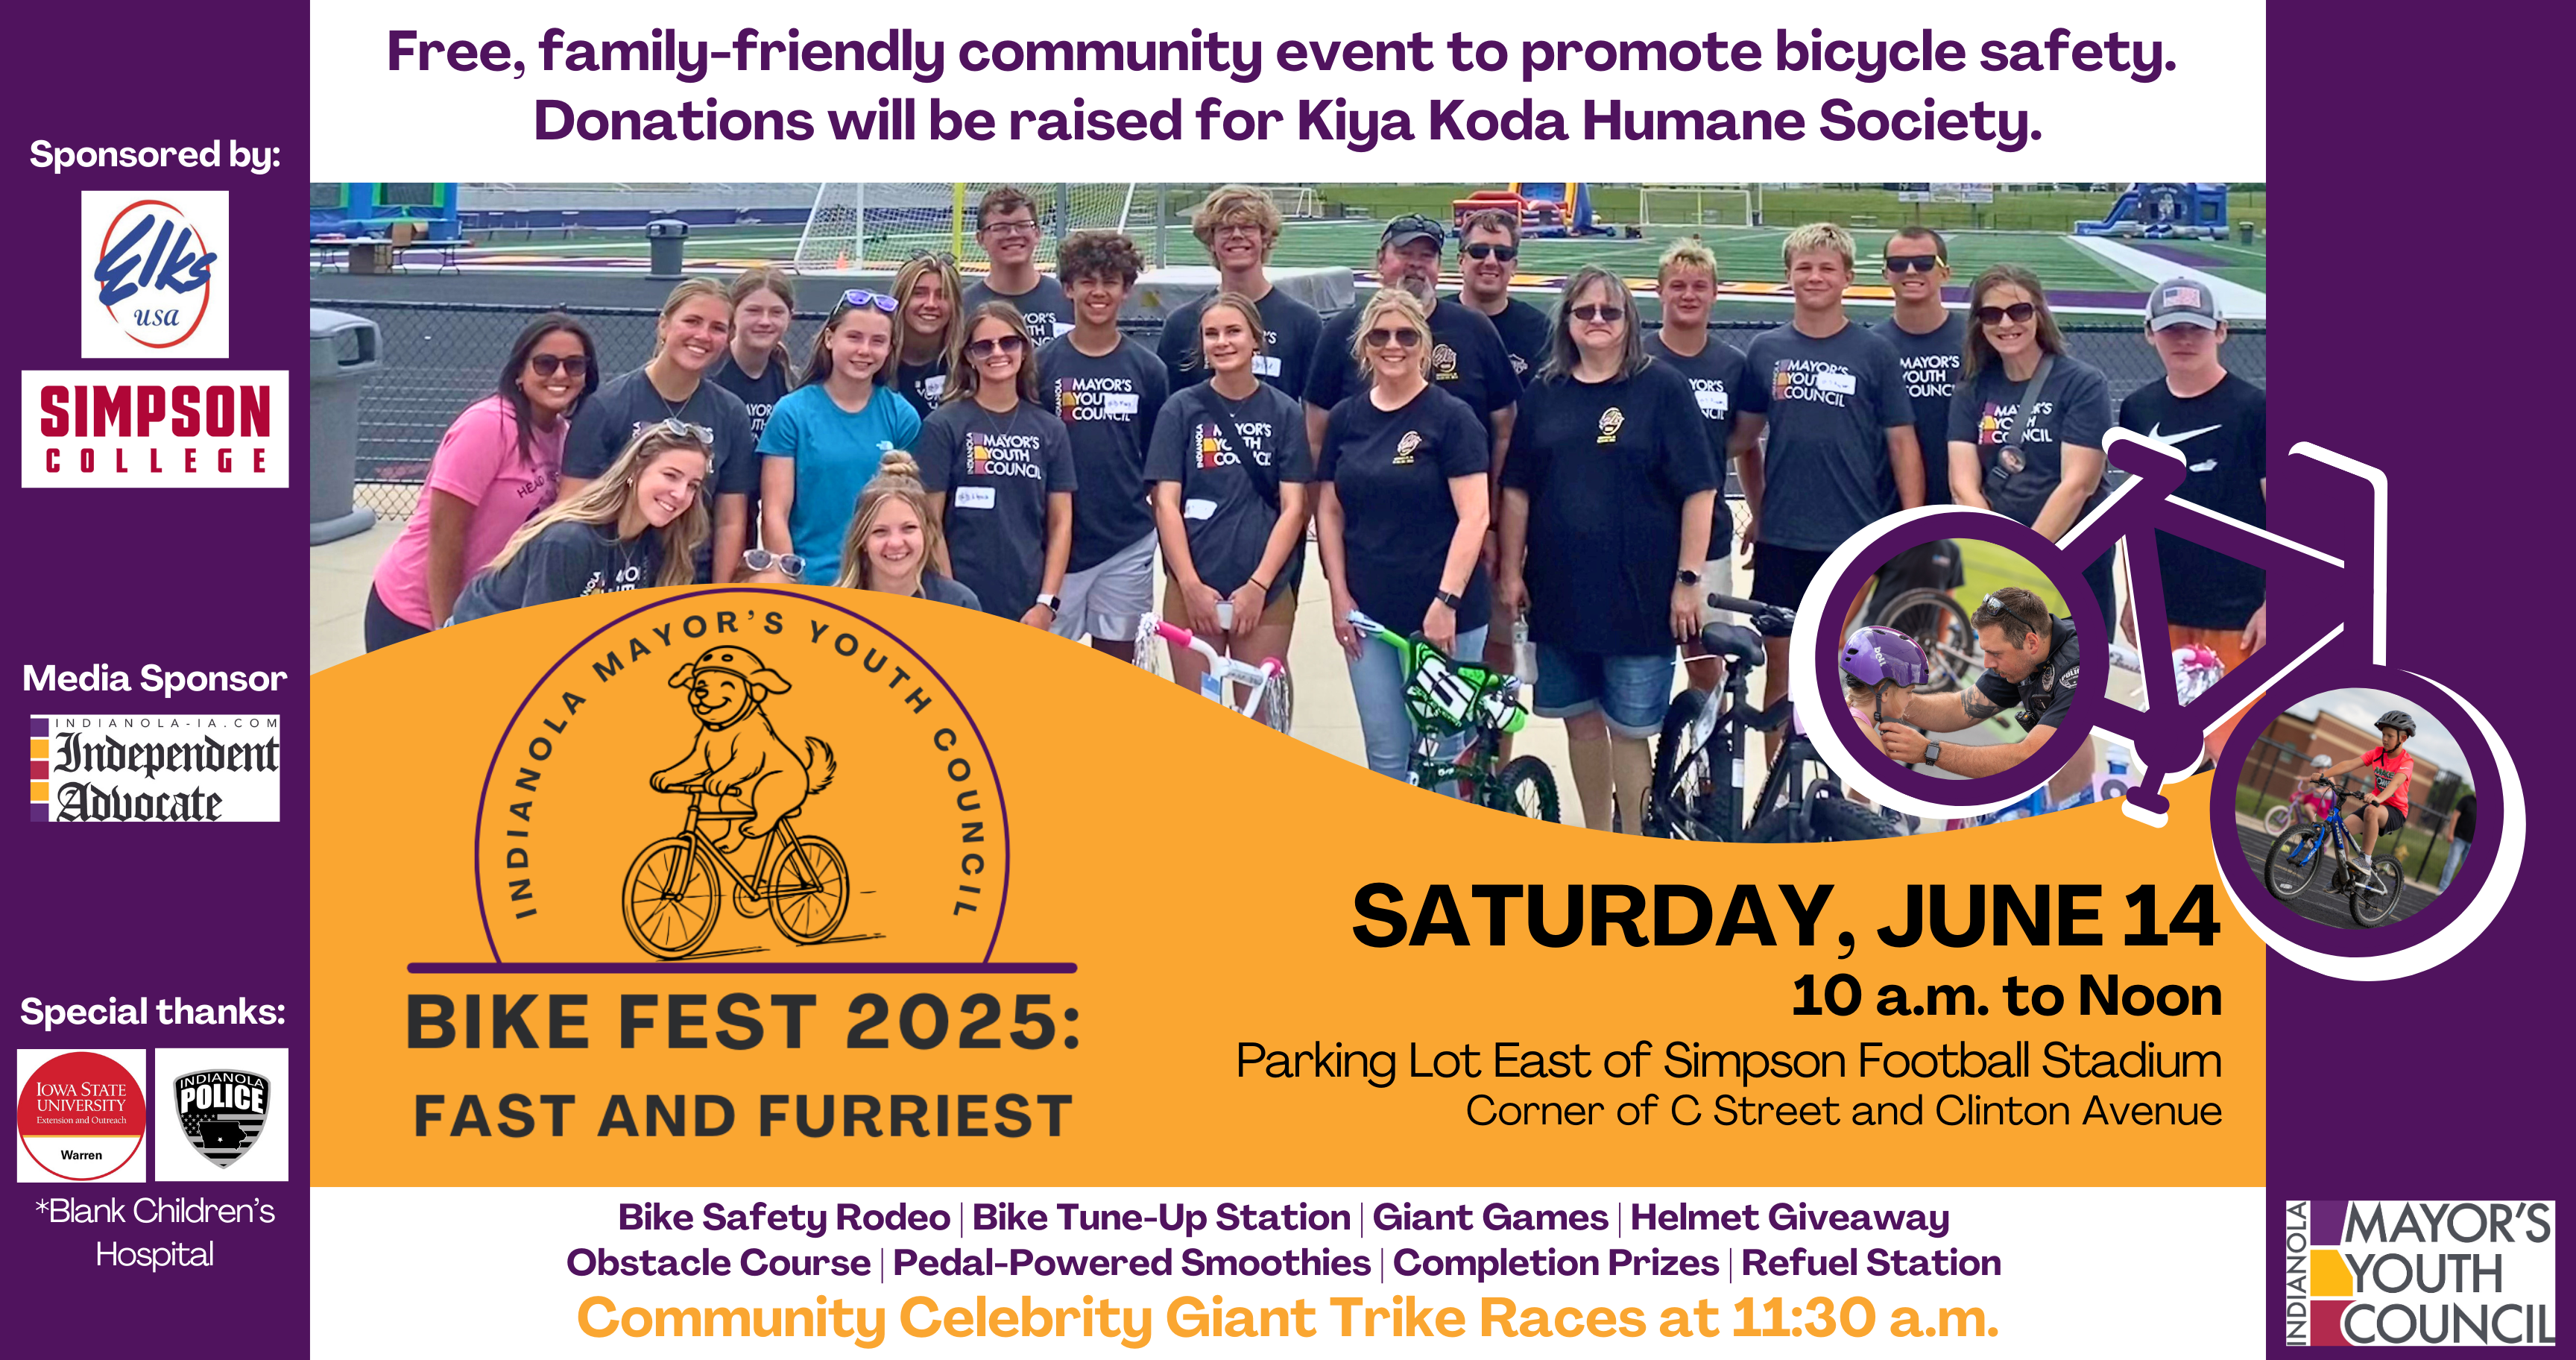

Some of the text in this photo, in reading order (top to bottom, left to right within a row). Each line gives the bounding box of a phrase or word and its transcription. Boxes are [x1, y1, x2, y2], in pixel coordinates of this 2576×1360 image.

[390, 28, 2175, 83] Free, family-friendly community event to promote bicycle safety.
[537, 98, 2041, 152] Donations will be raised for Kiya Koda Humane Society.
[31, 140, 280, 174] Sponsored by:
[94, 214, 218, 306] Elks
[134, 310, 179, 326] usa
[1900, 355, 1960, 369] MAYOR'S
[1073, 378, 1132, 391] MAYOR'S
[1787, 372, 1817, 387] YOU
[41, 386, 269, 436] SIMPSON
[1073, 392, 1105, 406] YOU
[1784, 386, 1845, 407] COUNCIL
[1213, 423, 1272, 438] MYOR'S
[1994, 415, 2036, 430] YOH
[984, 434, 1040, 450] MAYOR'S
[985, 448, 1030, 462] YOUTH
[1213, 437, 1261, 450] YOTH
[47, 449, 265, 472] COLLEGE
[985, 461, 1041, 479] COUNCIL
[1874, 646, 1886, 667] bell
[25, 664, 287, 697] Media Sponsor
[57, 719, 276, 727] INDIANOLA-IA.COM
[54, 732, 279, 779] Independent
[507, 610, 985, 919] INDIANOLA MAYOR'S YOUTH COUNCIL
[2374, 766, 2395, 778] MAKE
[57, 782, 222, 821] Advocate
[1353, 883, 2220, 959] SATURDAY, JUNE 14
[1794, 974, 2220, 1016] 10 a.m. to Noon
[21, 997, 284, 1031] Special thanks:
[408, 993, 1078, 1050] BIKE FEST 2025:
[1239, 1040, 2220, 1088] Parking Lot East of Simpson Football Stadium
[38, 1082, 126, 1096] Iowa State
[180, 1073, 264, 1089] INDIANOLA
[38, 1100, 125, 1111] UNIVERSITY
[180, 1083, 263, 1114] POLICE
[1468, 1094, 2222, 1125] Corner of C Street and Clinton Avenue
[417, 1094, 1072, 1137] FAST AND FURRIEST
[61, 1150, 101, 1159] Warren
[134, 1197, 275, 1223] Children's
[620, 1202, 1948, 1238] Bike Safety Rodeo Bike Tune-Up Station Giant Games Helmet Giveaway
[2345, 1201, 2551, 1243] MAYOR'S
[98, 1241, 212, 1272] Hospital
[567, 1247, 2001, 1282] Obstacle Course Pedal-Powered Smoothies Completion Prizes Refuel Station
[2286, 1201, 2307, 1345] INDIANOLA
[2345, 1253, 2501, 1293] YOUTH
[578, 1295, 1998, 1349] Community Celebrity Giant Trike Races at 11:30 a.m.
[2344, 1303, 2555, 1345] COUNCIL
